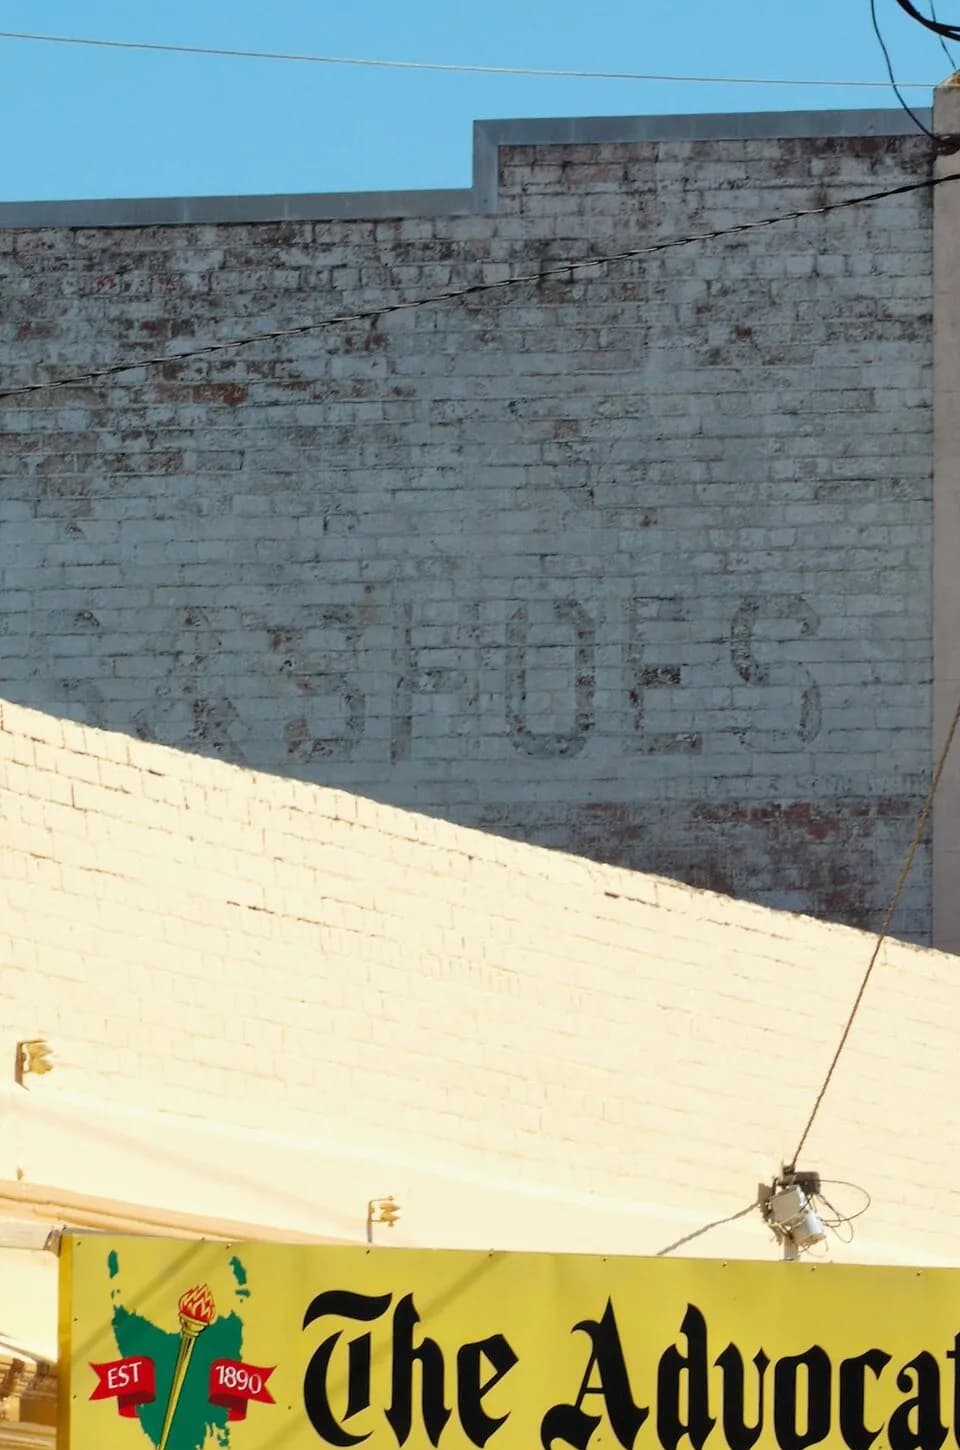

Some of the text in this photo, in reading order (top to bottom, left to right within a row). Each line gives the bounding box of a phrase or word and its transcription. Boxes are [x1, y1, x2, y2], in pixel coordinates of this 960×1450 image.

[107, 1362, 262, 1394] EST 1890
[302, 1290, 519, 1449] The
